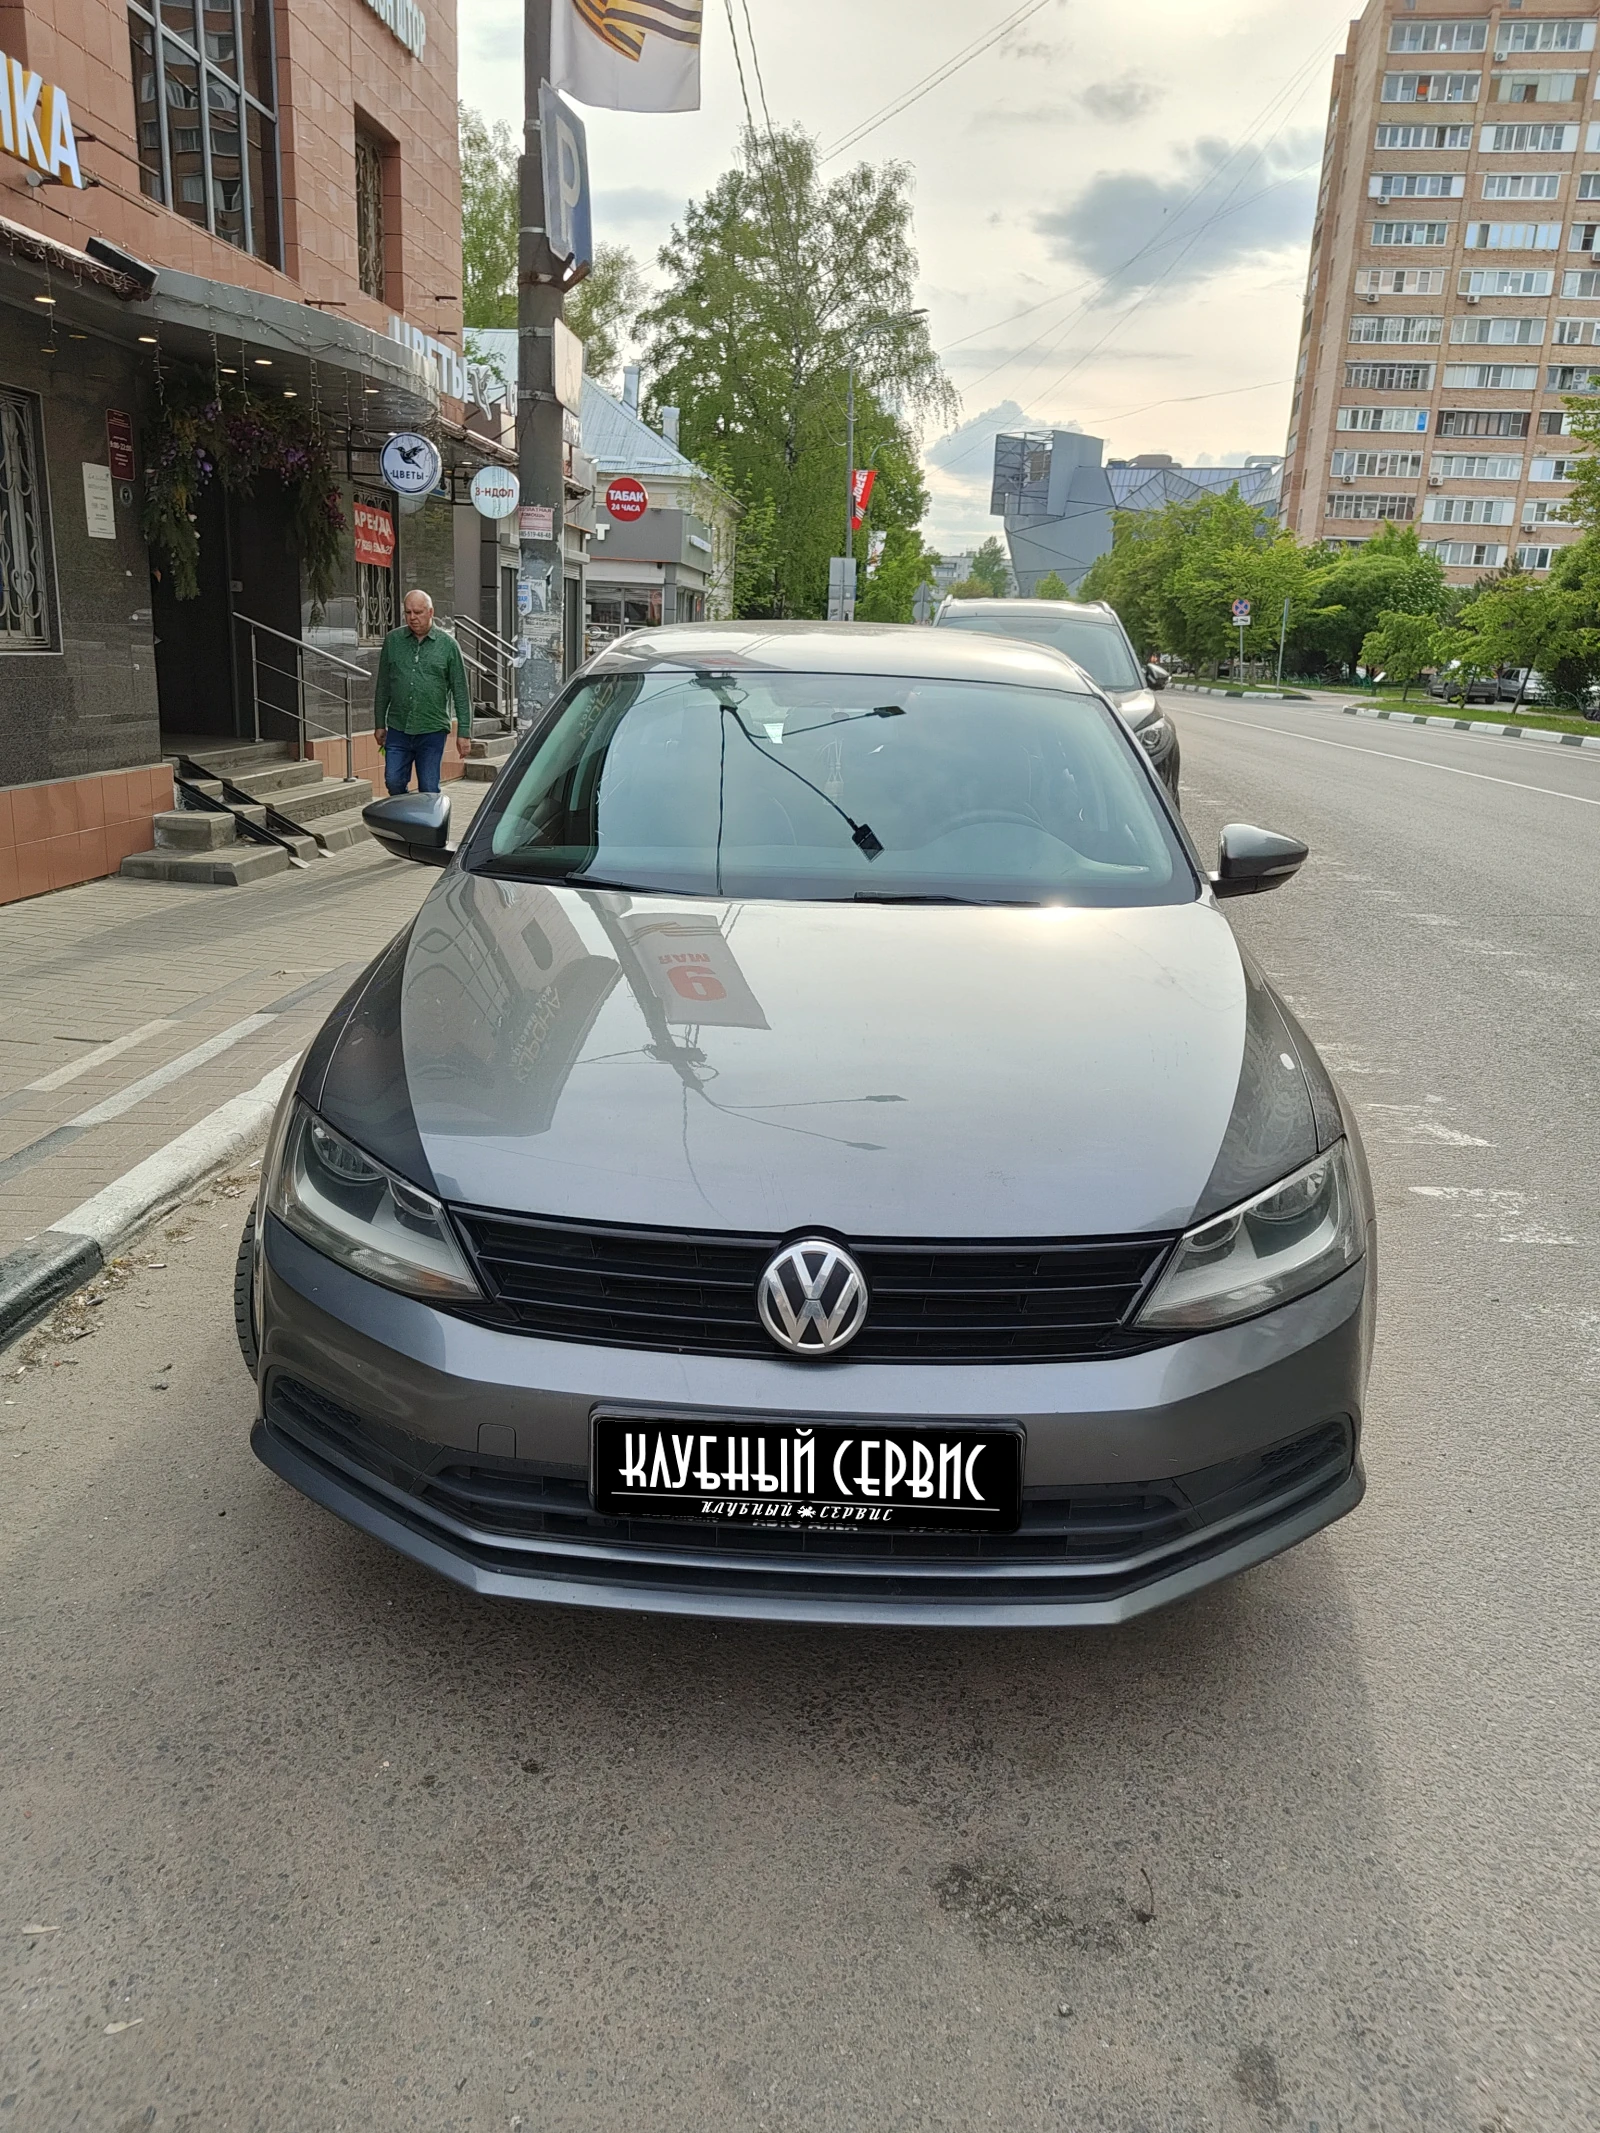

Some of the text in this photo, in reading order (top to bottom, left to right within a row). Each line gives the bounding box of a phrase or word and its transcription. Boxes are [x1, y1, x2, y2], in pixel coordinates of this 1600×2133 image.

[557, 114, 580, 243] P
[475, 487, 514, 498] 3-НДФЛ
[608, 490, 644, 502] ТАБАК
[611, 503, 640, 512] 24 ЧАСА
[354, 510, 392, 537] АРЕНДА
